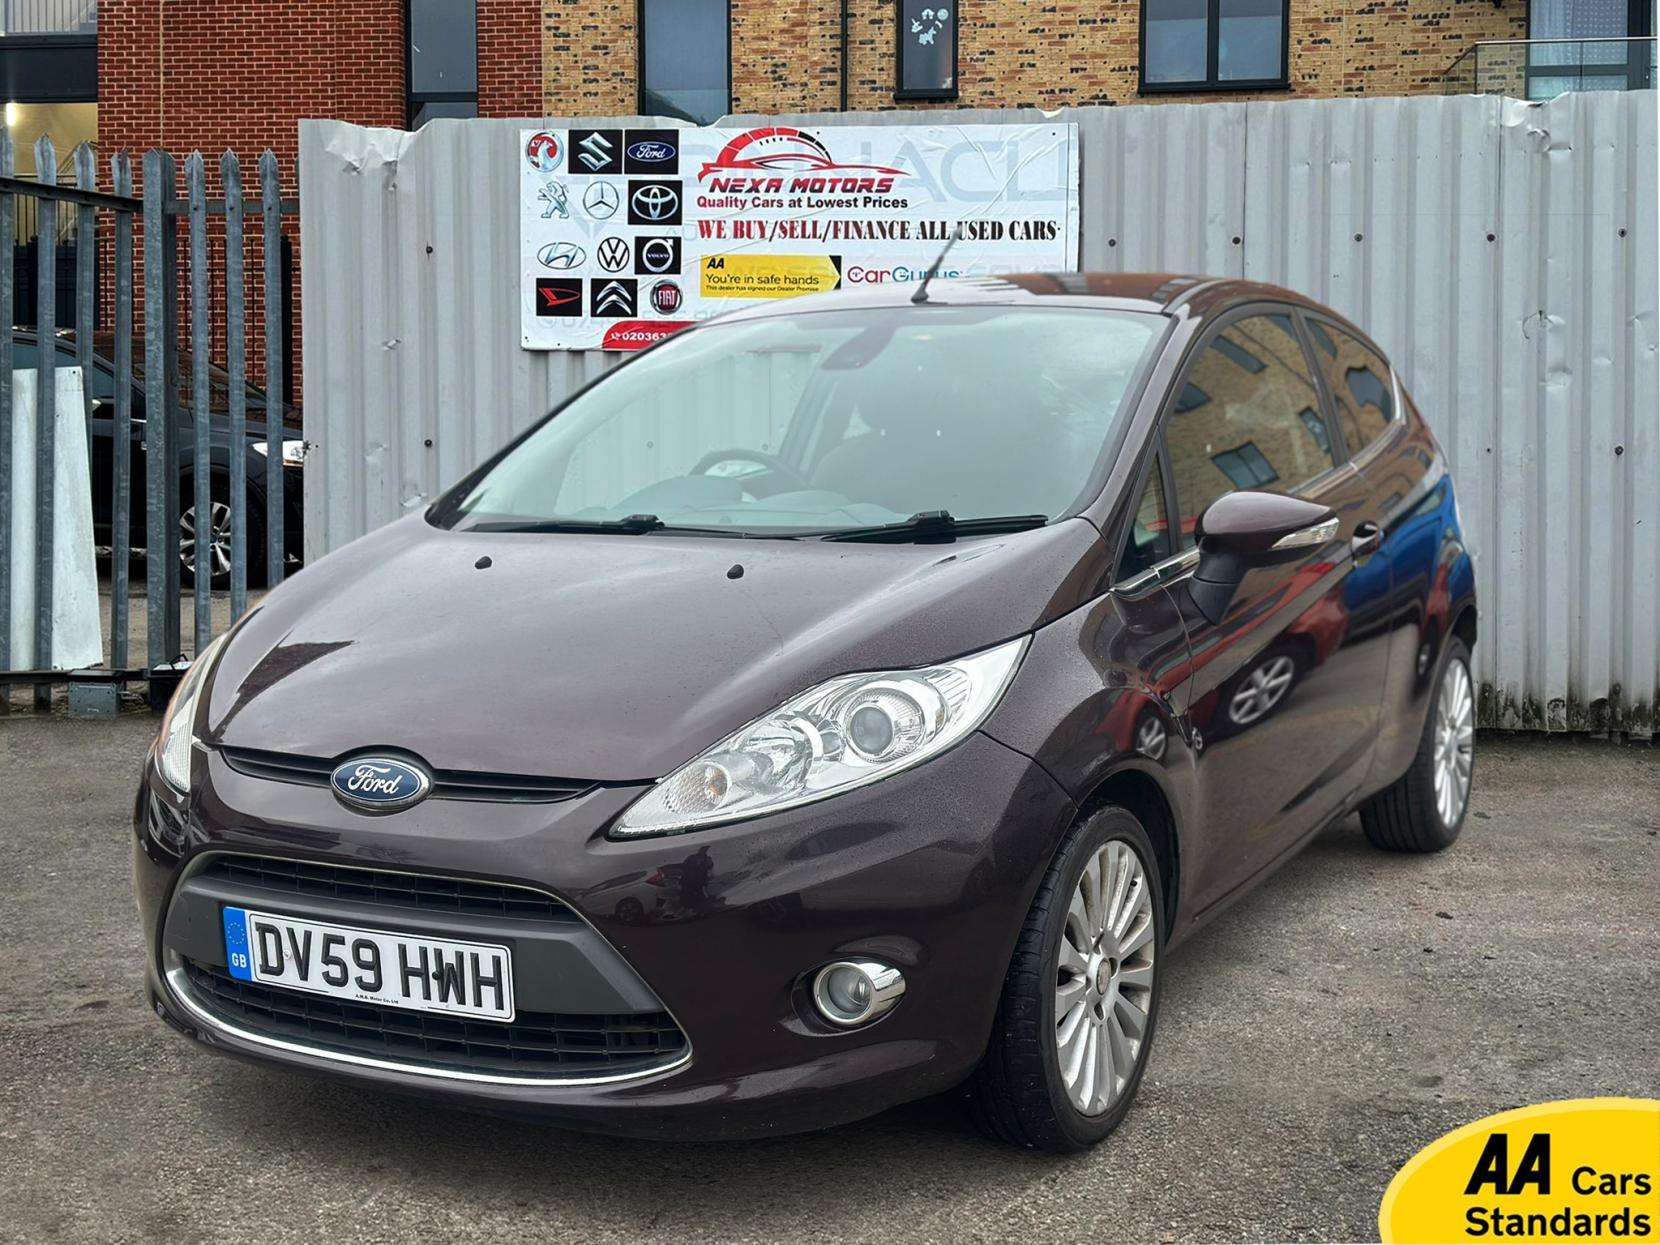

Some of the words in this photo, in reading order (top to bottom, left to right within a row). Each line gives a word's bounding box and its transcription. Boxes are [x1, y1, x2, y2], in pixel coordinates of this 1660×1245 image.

[635, 144, 667, 158] Ford
[709, 178, 784, 193] NEXA
[789, 178, 894, 193] MOTORS
[697, 196, 747, 210] Quality
[752, 196, 784, 208] Cars
[788, 197, 802, 208] at
[807, 196, 858, 208] Lowest
[863, 196, 908, 208] Prices
[697, 220, 727, 239] WE
[733, 220, 911, 242] BUY/SELL/FINANCE
[915, 221, 950, 240] ALL
[957, 220, 1003, 241] USED
[1009, 220, 1056, 241] CARS
[707, 258, 725, 269] AA
[706, 274, 741, 284] You're
[744, 274, 754, 284] in
[757, 274, 780, 284] safe
[784, 275, 819, 285] hands
[658, 290, 676, 305] FIAT
[348, 764, 403, 794] Ford
[231, 952, 247, 968] GB
[254, 921, 384, 993] DV59
[398, 942, 504, 1010] HWH
